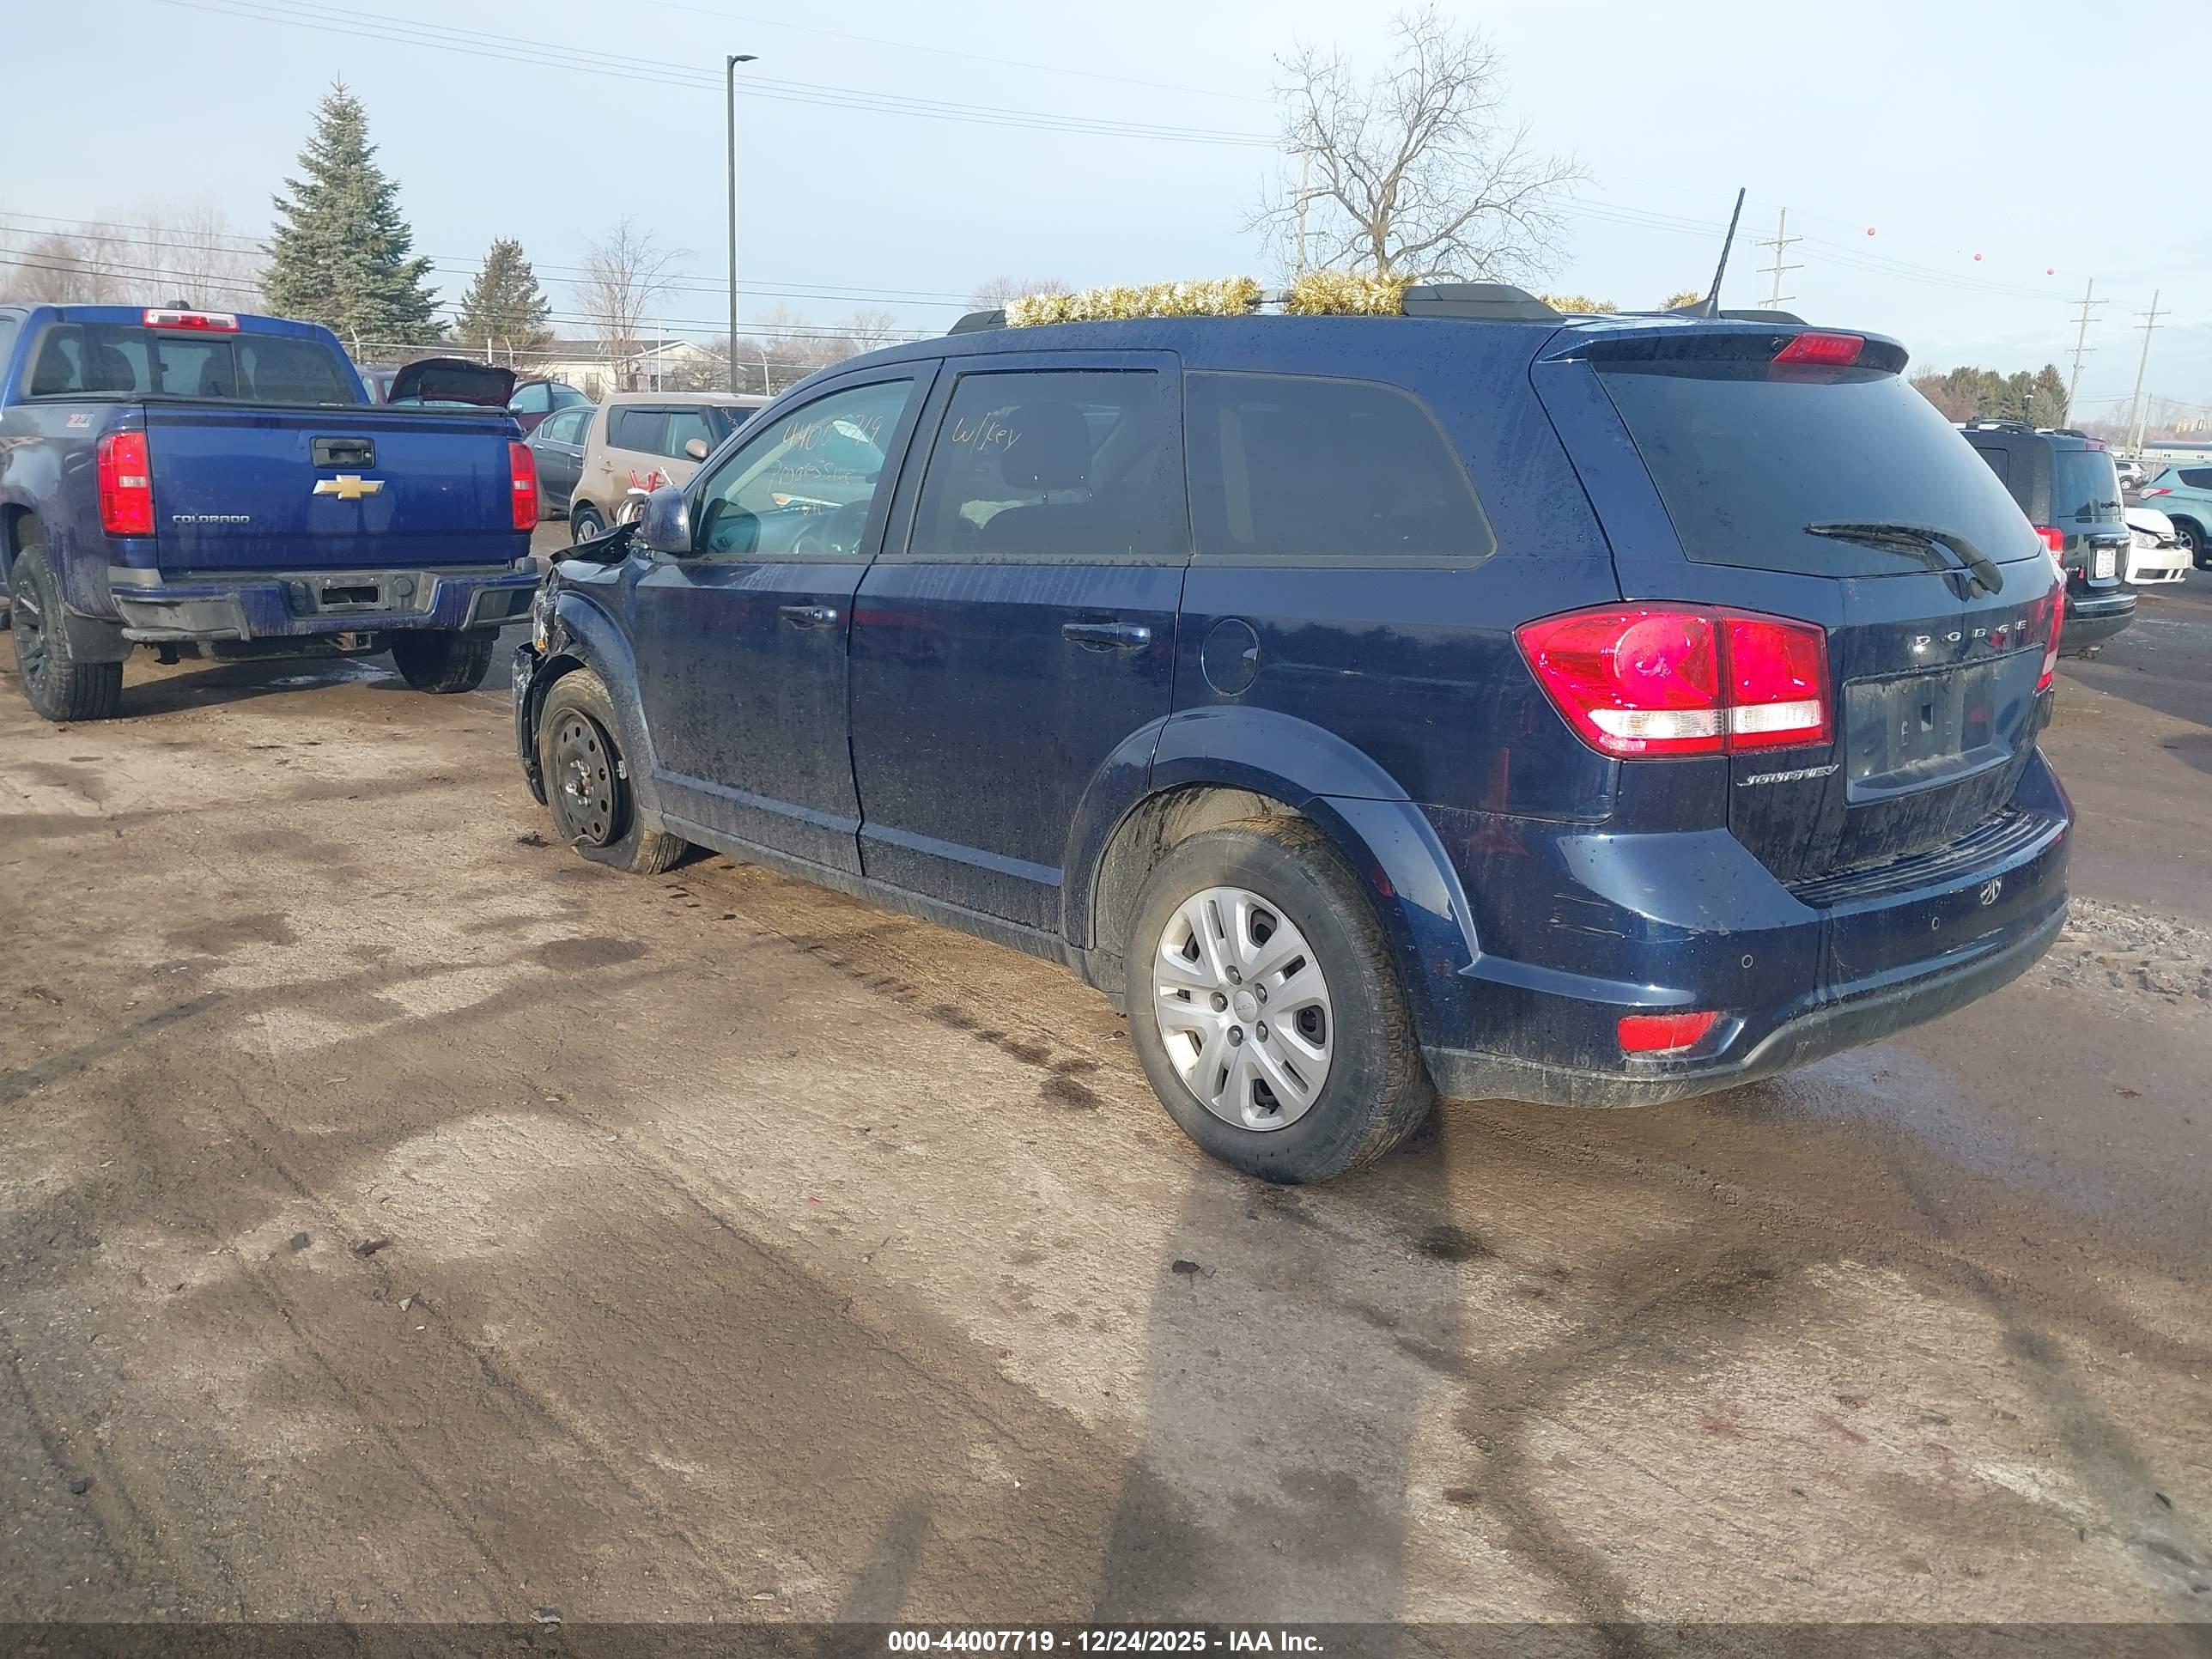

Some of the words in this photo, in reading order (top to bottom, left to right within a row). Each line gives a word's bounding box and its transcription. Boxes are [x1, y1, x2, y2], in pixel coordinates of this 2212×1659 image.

[172, 514, 251, 524] COLORADO
[1914, 619, 2028, 647] DODGE
[1736, 763, 1841, 787] JOURNEY
